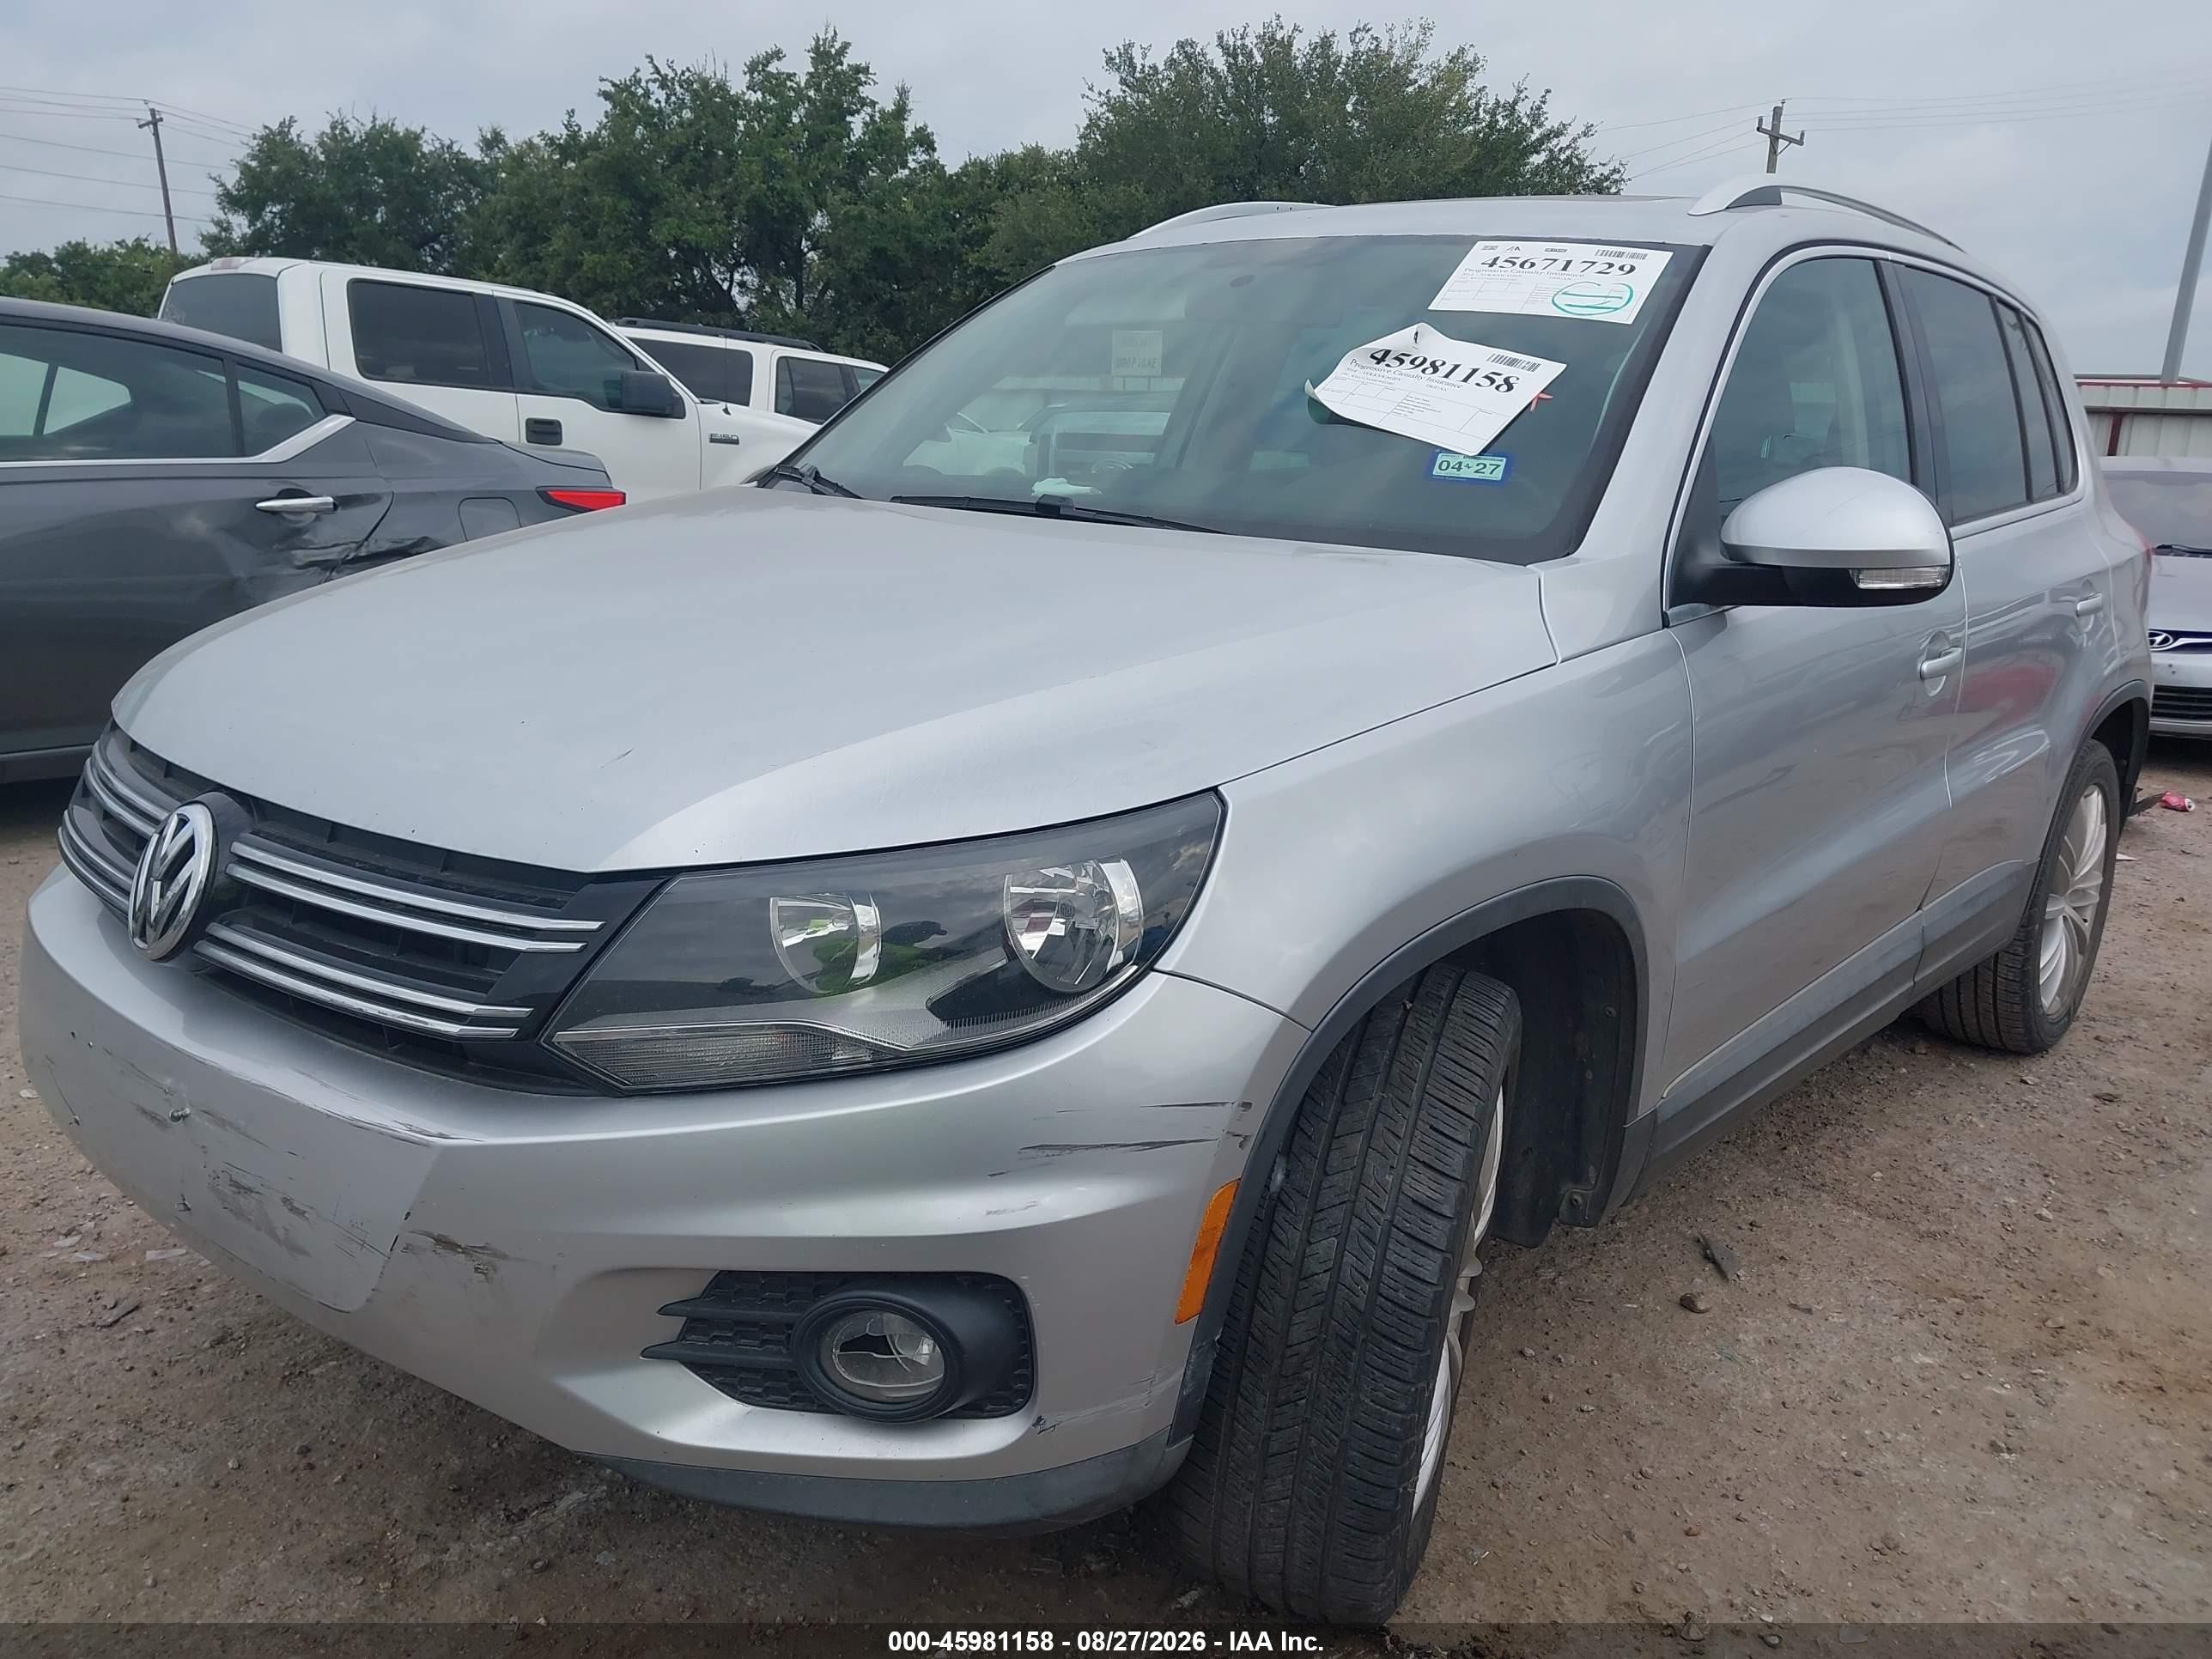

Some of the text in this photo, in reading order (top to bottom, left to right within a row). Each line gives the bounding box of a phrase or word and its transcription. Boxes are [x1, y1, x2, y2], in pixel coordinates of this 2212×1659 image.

[1480, 256, 1636, 276] 45671729
[1350, 358, 1392, 374] Progressive
[1393, 370, 1424, 380] Casualty
[1425, 376, 1463, 389] Insurance
[1369, 349, 1520, 393] 45981158
